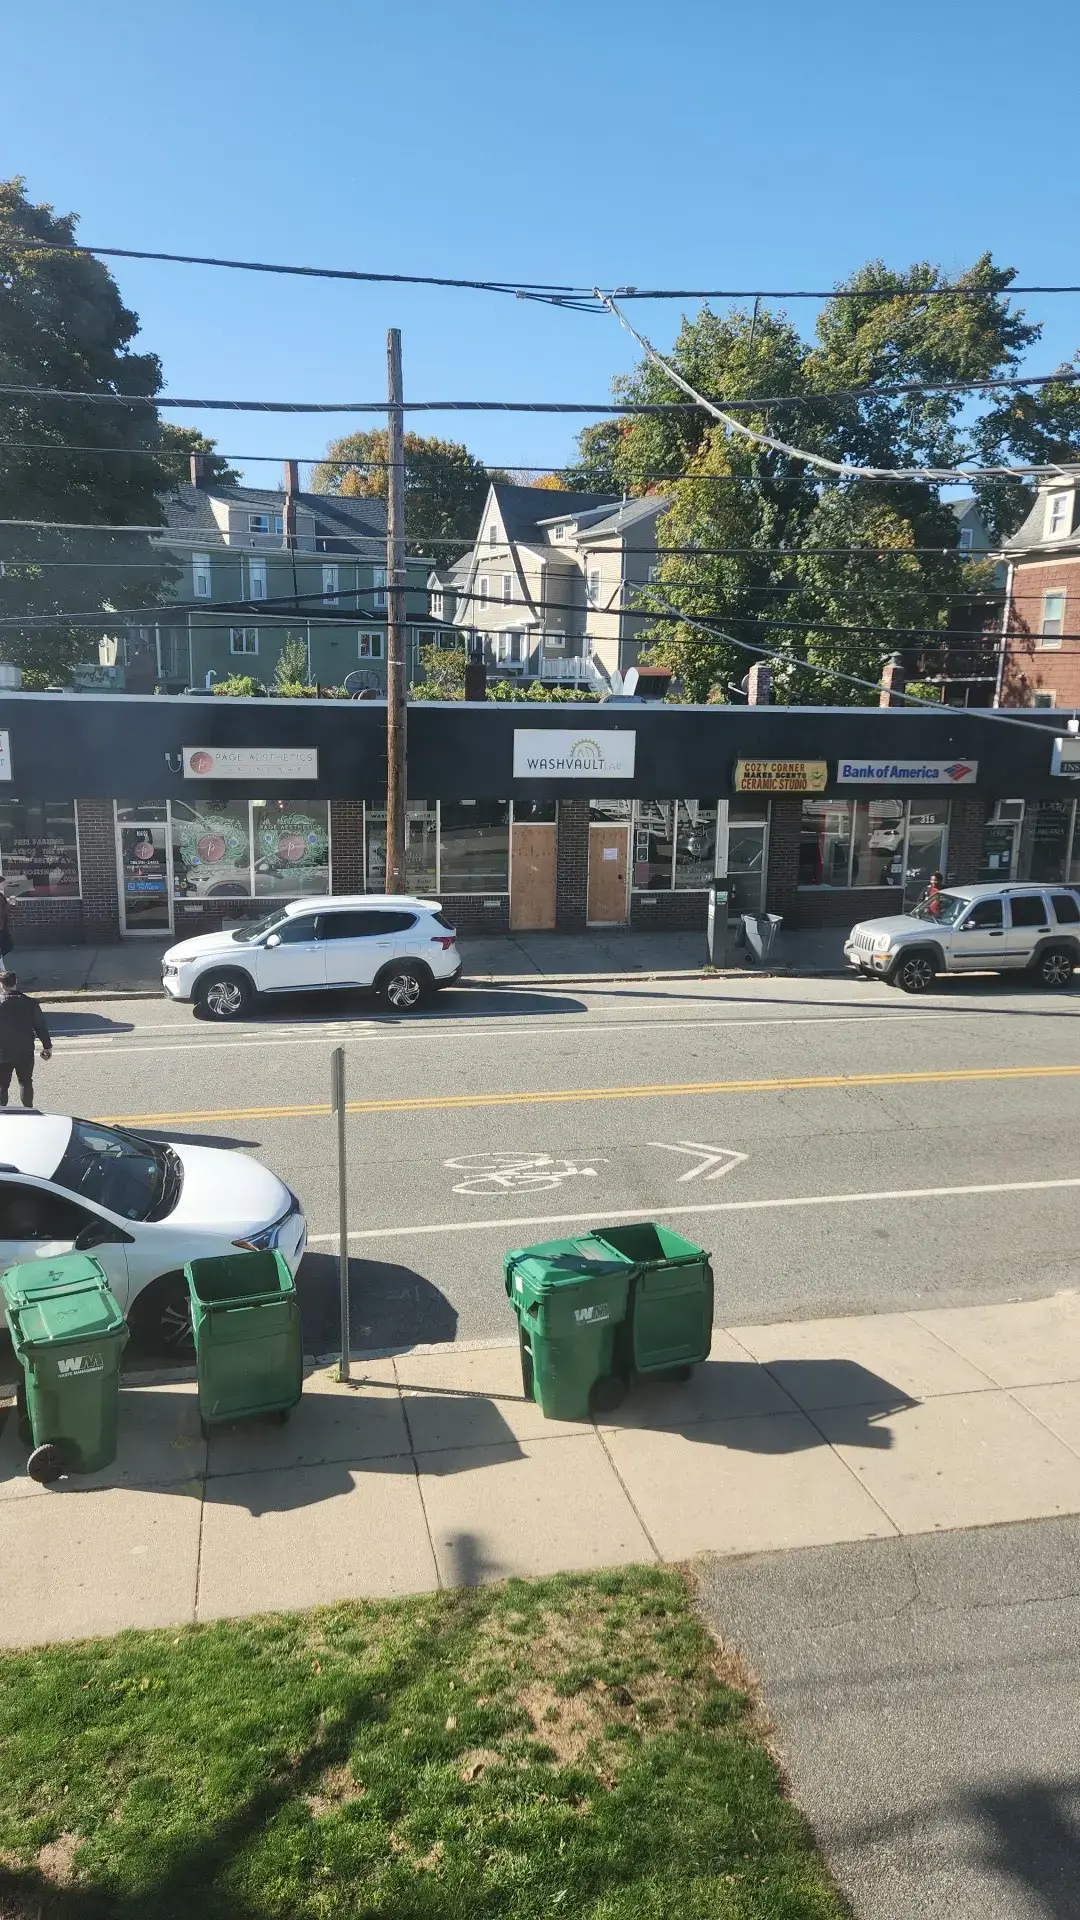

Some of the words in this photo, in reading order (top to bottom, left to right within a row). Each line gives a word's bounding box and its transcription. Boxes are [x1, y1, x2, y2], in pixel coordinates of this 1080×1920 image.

[215, 753, 242, 762] PAGE
[527, 758, 605, 770] WASHVAULT
[744, 763, 768, 772] COZY
[771, 763, 805, 772] CORNER
[842, 765, 875, 778] Bank
[876, 765, 890, 778] of
[890, 765, 939, 778] America
[741, 779, 777, 790] CERAMIC
[779, 779, 808, 790] STUDIO
[920, 815, 935, 824] 315
[57, 1352, 104, 1374] WM
[73, 1365, 104, 1376] MANAGEMENT
